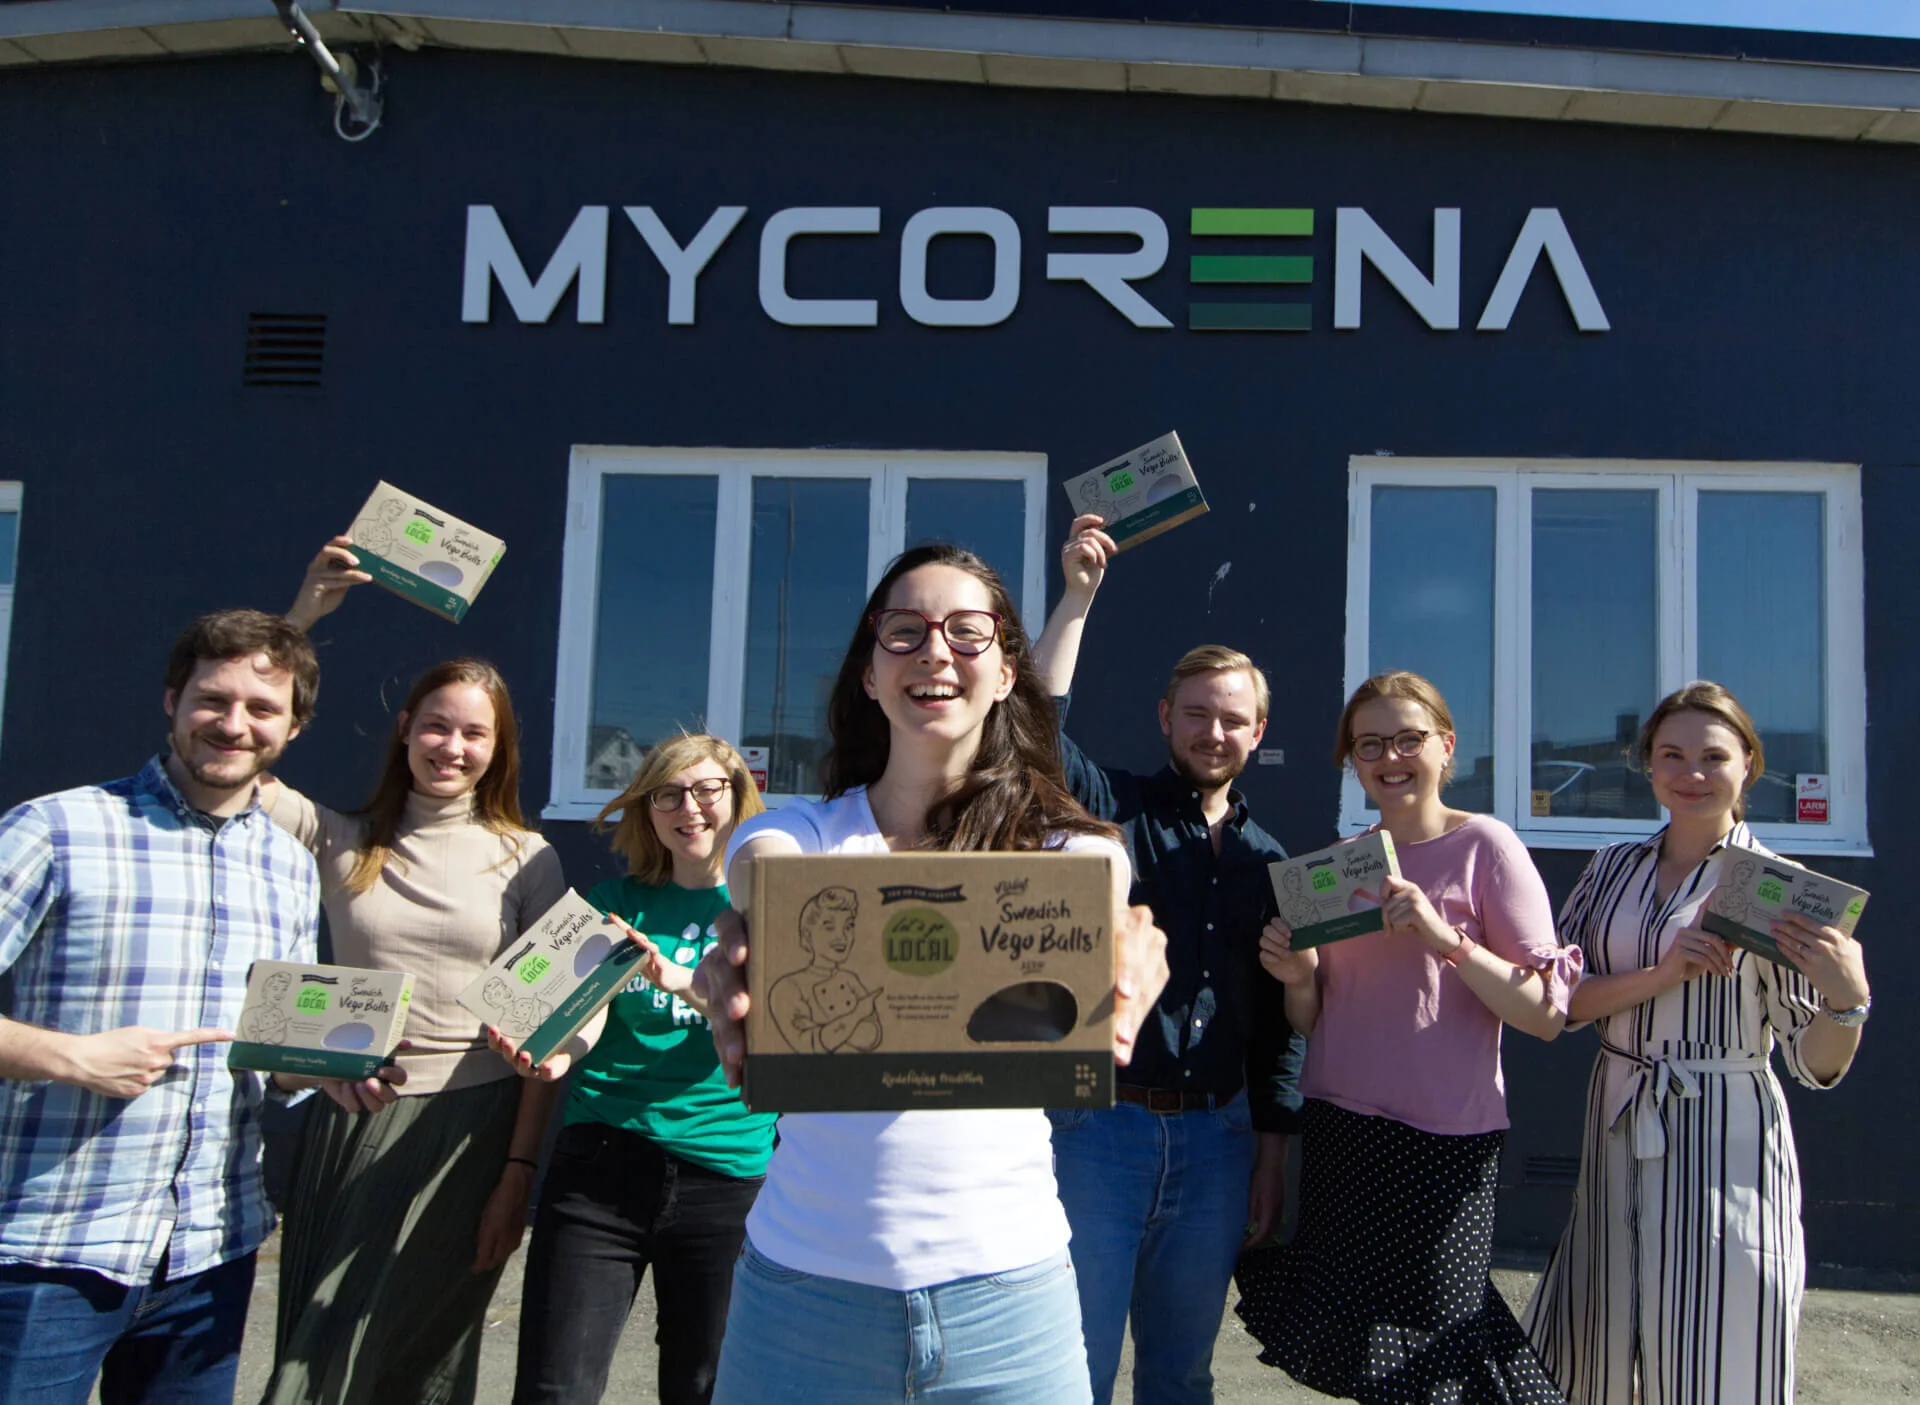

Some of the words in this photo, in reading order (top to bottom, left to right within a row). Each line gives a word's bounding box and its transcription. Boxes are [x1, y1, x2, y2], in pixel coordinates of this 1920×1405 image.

[461, 205, 1611, 331] MYCORENA
[1800, 802, 1826, 810] LARM
[1000, 899, 1071, 923] Swedish
[887, 937, 955, 962] LOCAL
[980, 923, 1034, 961] Vego
[1039, 923, 1102, 953] Balls!
[523, 959, 551, 984] LOCAL
[296, 997, 327, 1010] LOCAL
